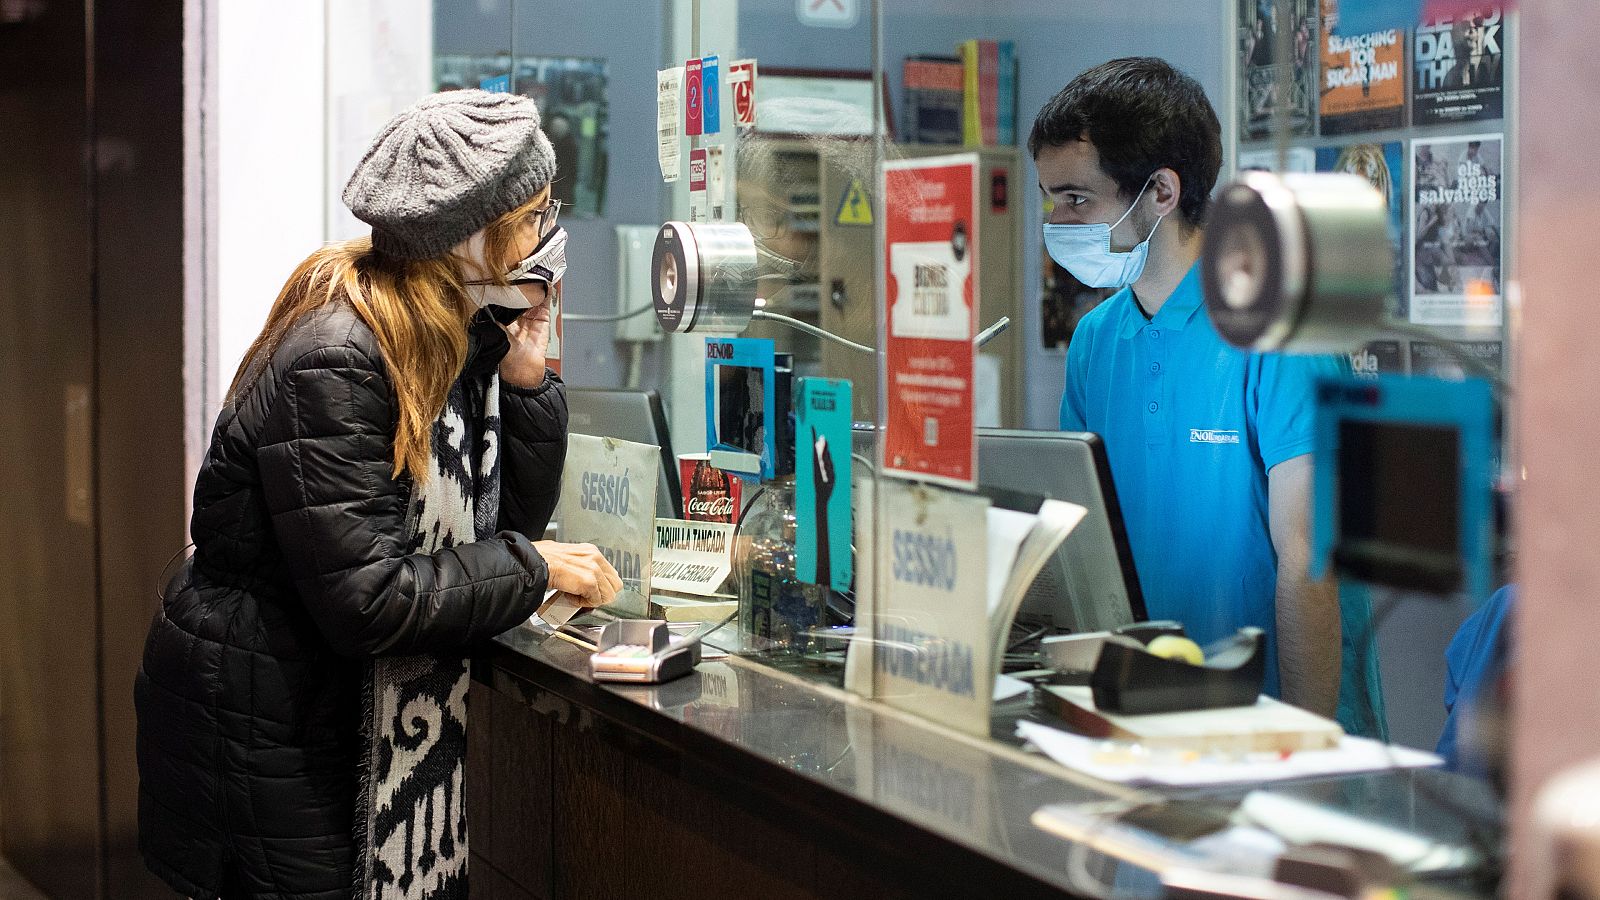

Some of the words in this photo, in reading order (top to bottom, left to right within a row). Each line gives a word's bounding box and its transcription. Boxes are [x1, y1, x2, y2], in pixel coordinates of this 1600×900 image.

[1328, 29, 1397, 54] SEARCHING
[1350, 48, 1376, 66] FOR
[1327, 65, 1367, 88] SUGAR
[1369, 60, 1398, 81] MAN
[690, 86, 697, 108] 2
[1458, 160, 1480, 176] els
[1458, 174, 1497, 189] nens
[1419, 185, 1497, 205] salvatges
[707, 343, 734, 359] RENOIR
[581, 468, 630, 517] SESSIÓ
[688, 497, 736, 516] Coca-Cola
[656, 525, 691, 552] TAQUILLA
[692, 528, 727, 554] TANCADA
[892, 526, 958, 592] SESSIÓ
[676, 564, 720, 584] CERRADA
